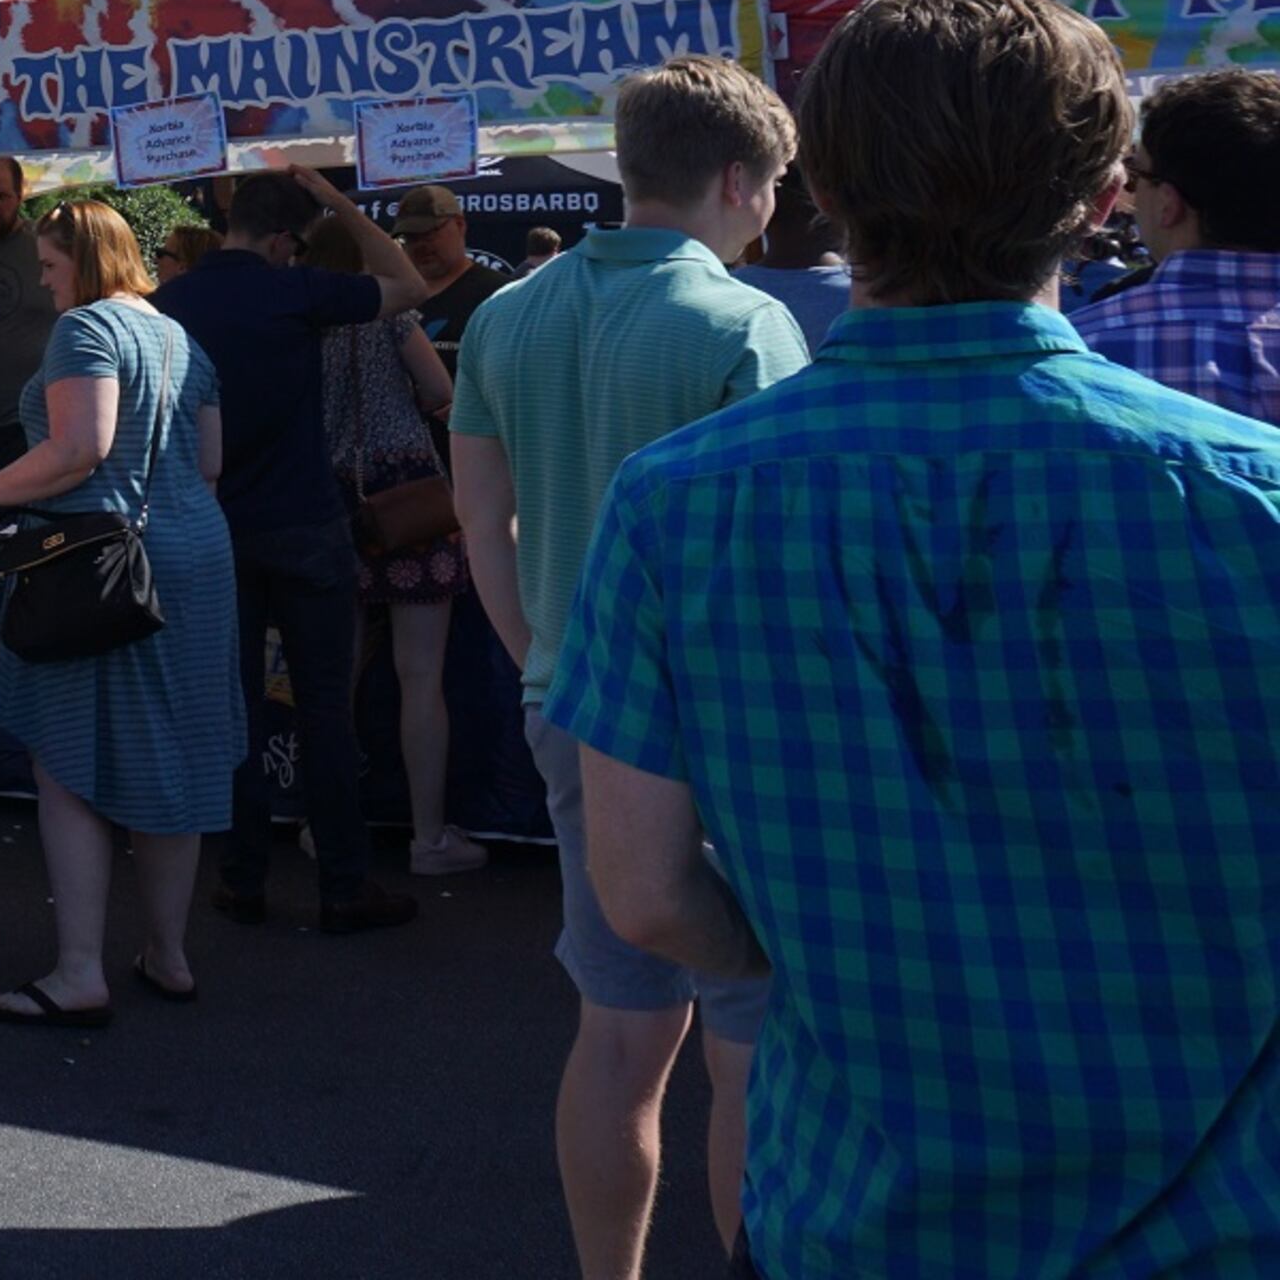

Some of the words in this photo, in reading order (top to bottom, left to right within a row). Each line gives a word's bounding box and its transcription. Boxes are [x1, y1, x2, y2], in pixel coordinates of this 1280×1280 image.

[11, 45, 152, 120] THE
[145, 135, 192, 150] Advance
[390, 137, 441, 149] Advance
[146, 149, 197, 163] Purchase
[390, 151, 445, 164] Purchase
